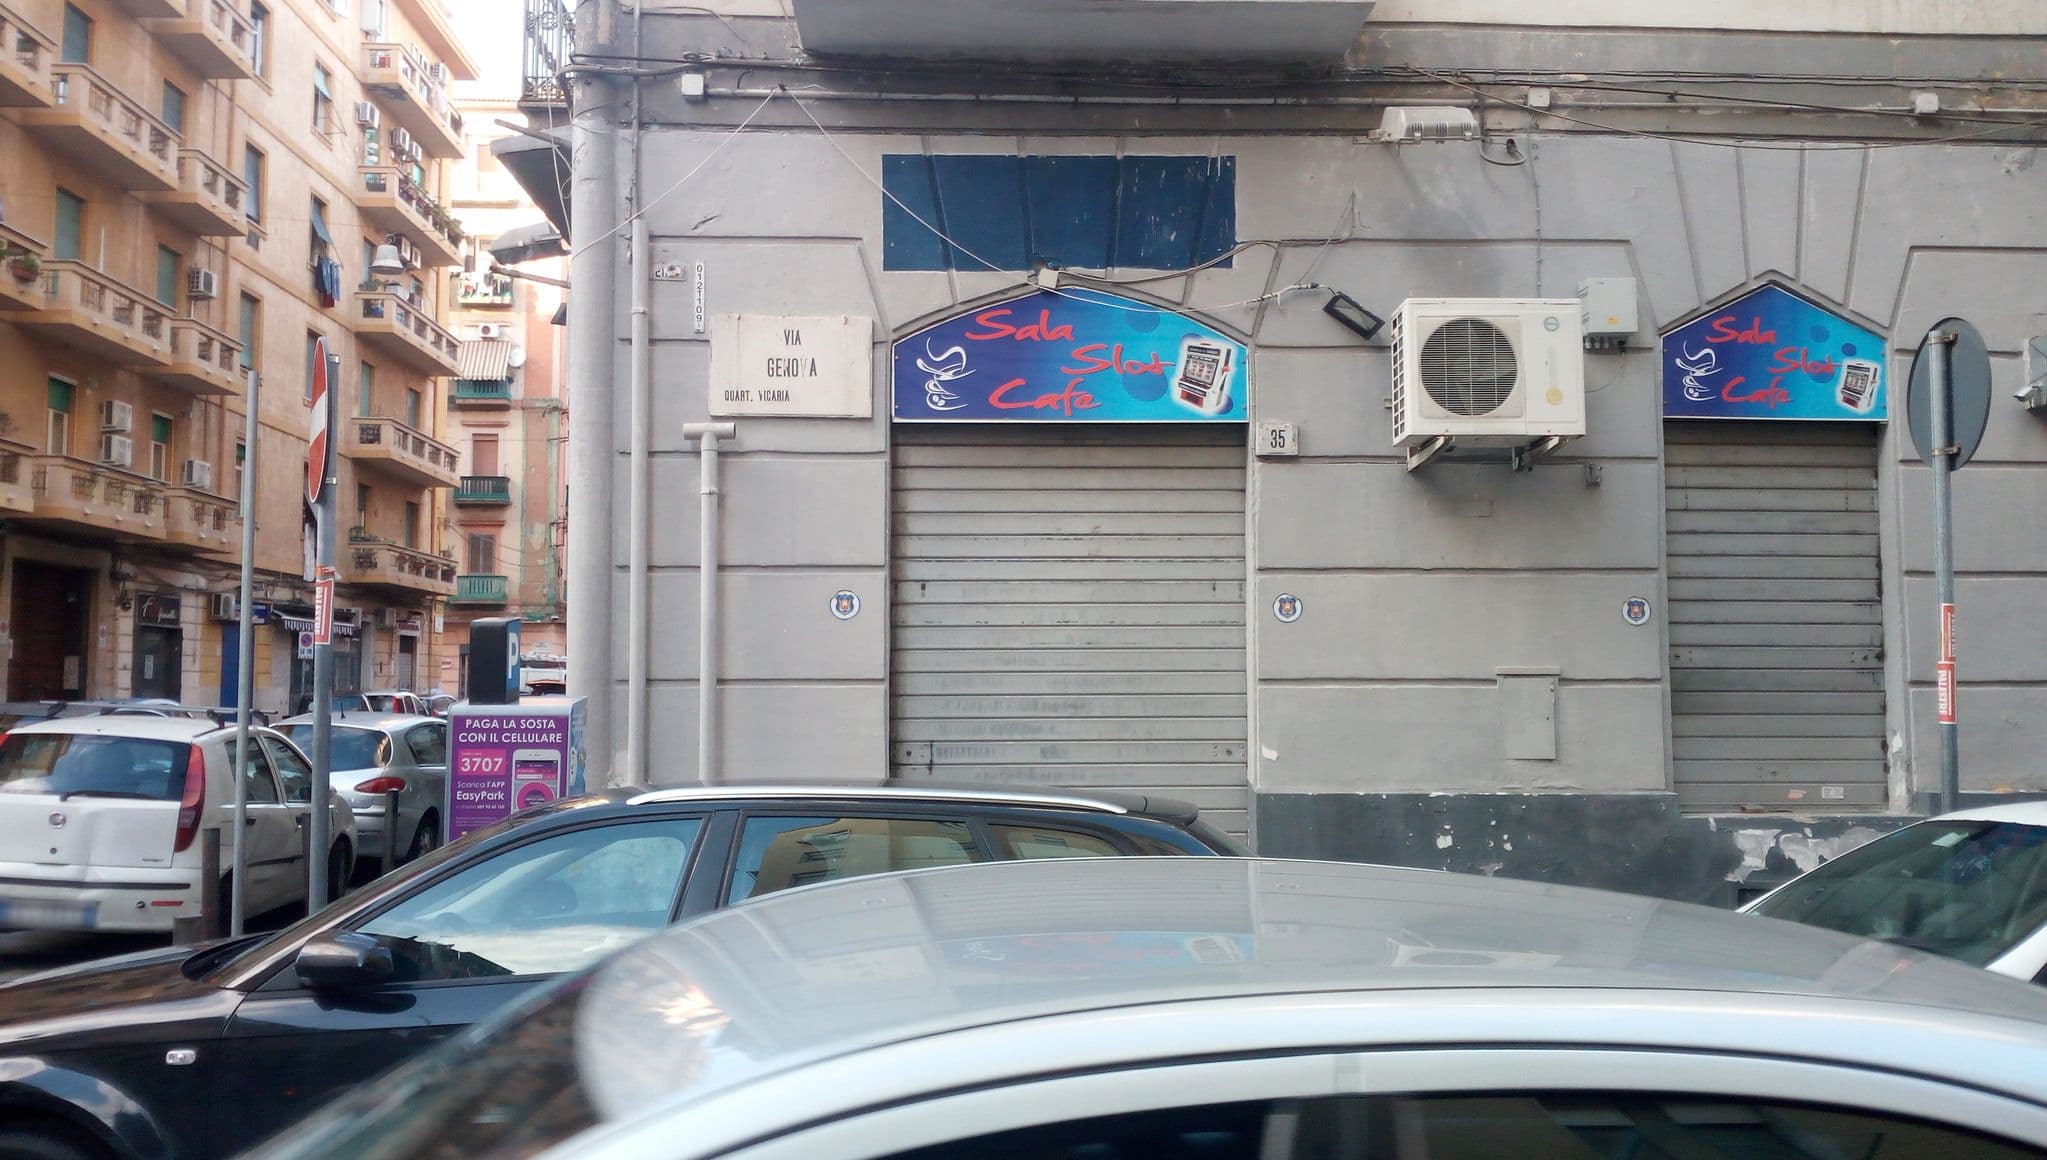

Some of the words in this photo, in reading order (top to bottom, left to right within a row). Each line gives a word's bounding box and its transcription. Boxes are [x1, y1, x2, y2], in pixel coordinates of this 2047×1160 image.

[965, 309, 1075, 341] Sala
[1706, 316, 1776, 344] Sala
[784, 329, 801, 346] VIA
[1061, 344, 1176, 375] Slot
[1767, 347, 1842, 375] Slot
[724, 390, 754, 402] QUART.
[758, 390, 790, 402] VICARIA
[988, 378, 1102, 417] Cafe
[1270, 429, 1286, 449] 35
[508, 632, 519, 679] P
[465, 719, 499, 729] PAGA
[502, 719, 517, 729] LA
[520, 719, 556, 729] SOSTA
[458, 732, 487, 743] CON
[489, 732, 499, 743] IL
[501, 732, 562, 743] CELLULARE
[460, 757, 504, 773] 3707
[457, 781, 486, 789] Scarica
[456, 790, 505, 803] EasyPark
